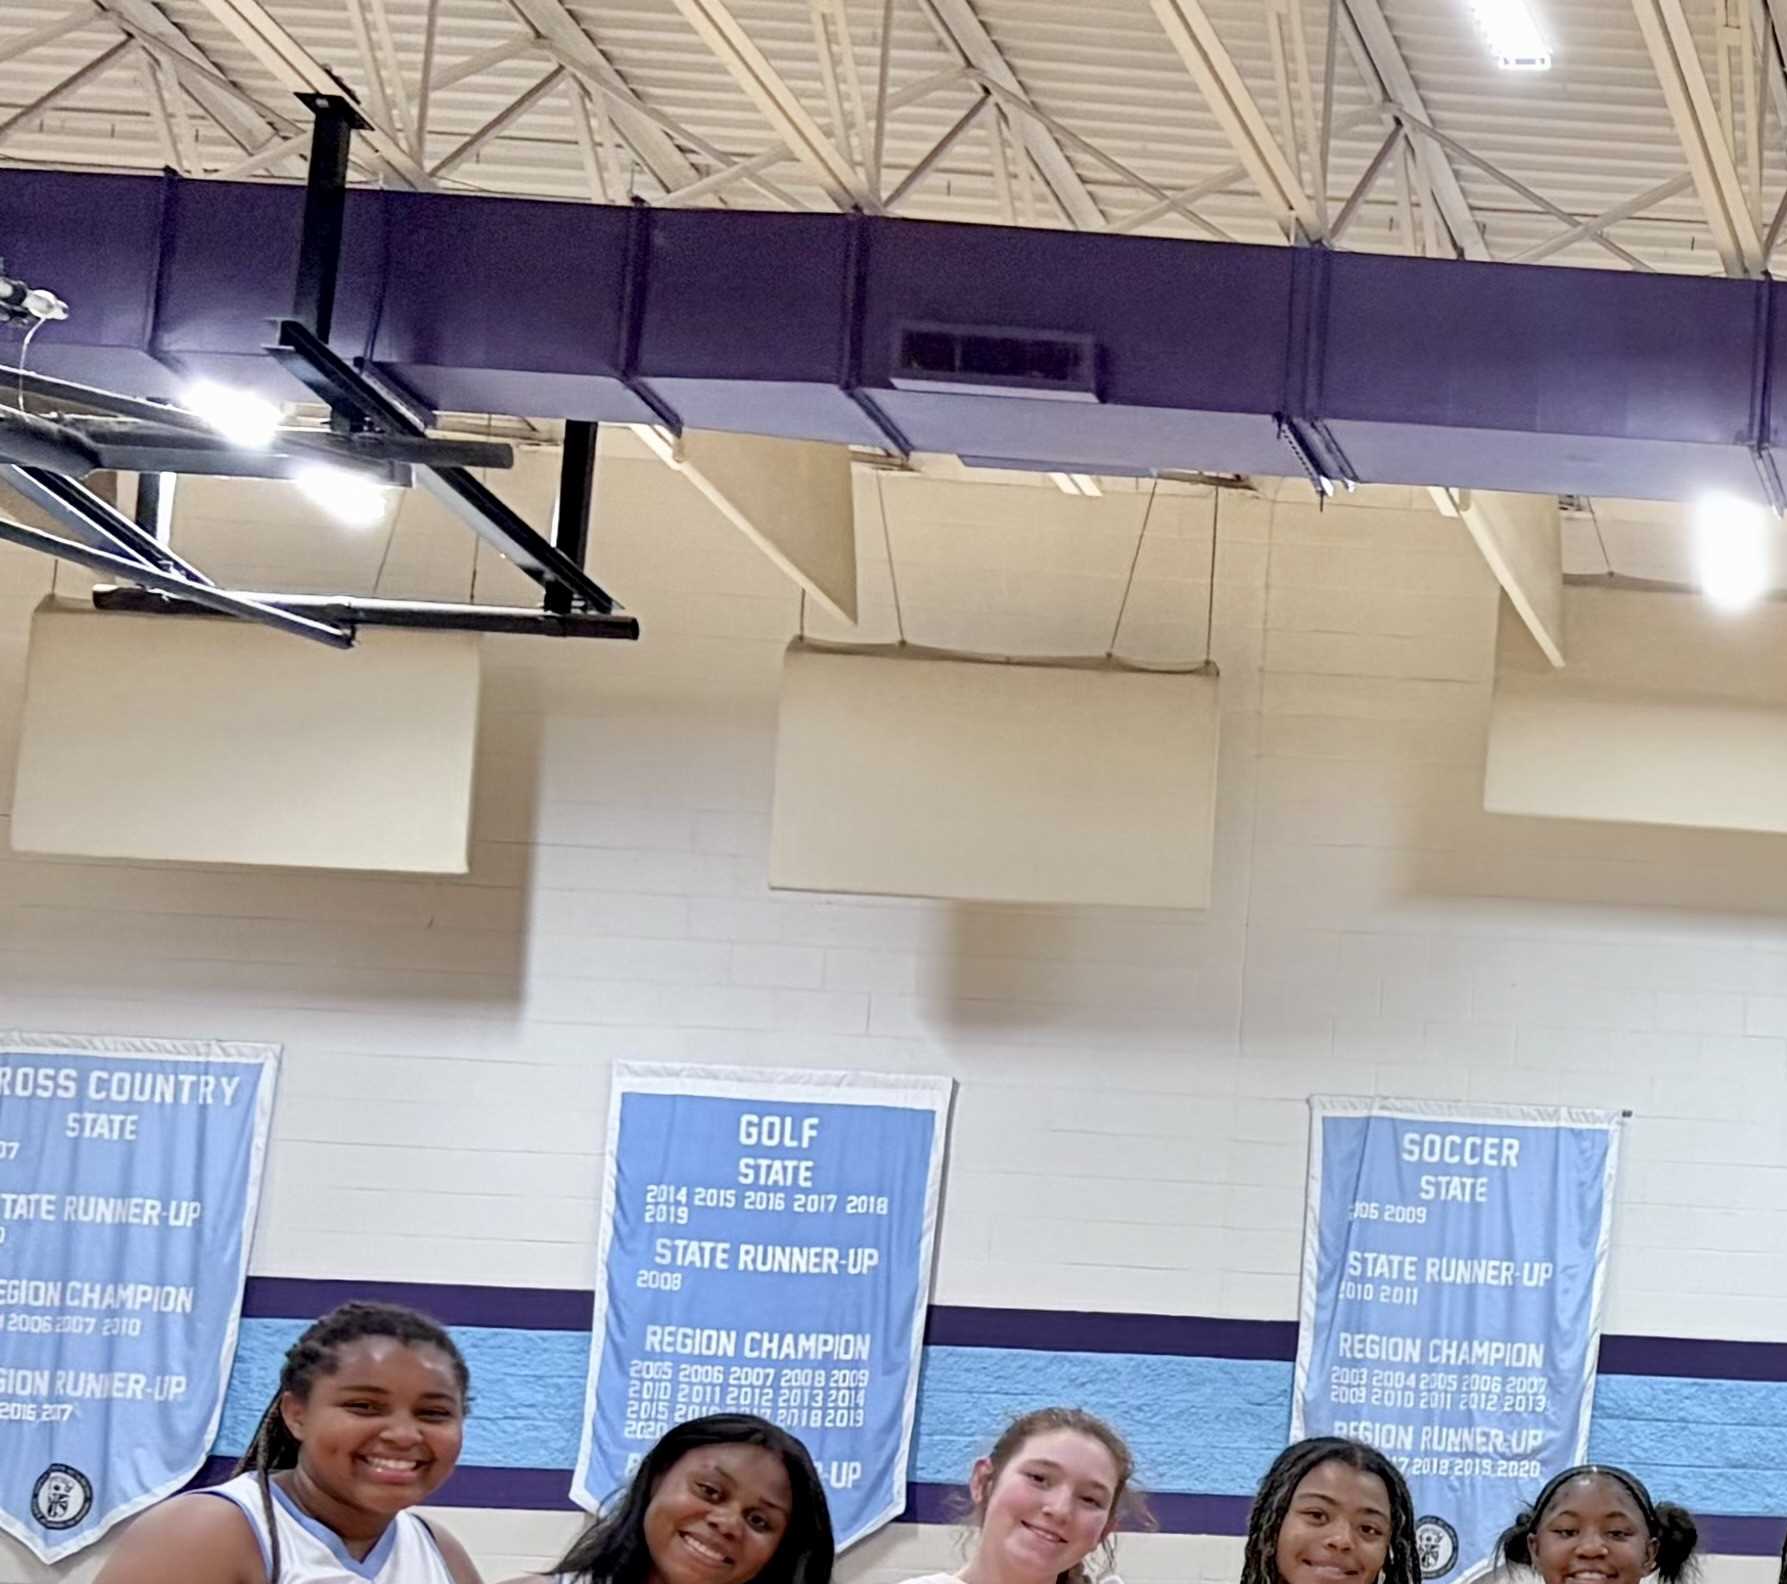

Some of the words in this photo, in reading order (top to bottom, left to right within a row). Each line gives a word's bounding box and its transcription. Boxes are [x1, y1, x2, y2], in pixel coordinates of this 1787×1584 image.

[0, 1066, 78, 1099] ROSS
[88, 1070, 240, 1106] COUNTRY
[65, 1111, 139, 1140] STATE
[738, 1113, 820, 1149] GOLF
[1401, 1133, 1520, 1167] SOCCER
[737, 1157, 815, 1188] STATE
[645, 1184, 688, 1205] 2014
[693, 1187, 736, 1209] 2015
[743, 1190, 786, 1211] 2016
[792, 1193, 838, 1214] 2017
[846, 1195, 889, 1216] 2018
[1419, 1174, 1488, 1203] STATE
[0, 1193, 56, 1221] TATE
[64, 1195, 201, 1227] RUNNER-UP
[644, 1204, 688, 1225] 2019
[1384, 1203, 1427, 1223] 2009
[654, 1238, 730, 1270] STATE
[738, 1243, 879, 1275] RUNNER-UP
[1348, 1251, 1418, 1281] STATE
[1425, 1256, 1553, 1287] RUNNER-UP
[636, 1269, 683, 1291] 2008
[1380, 1284, 1418, 1305] 2011
[0, 1279, 65, 1308] EGION
[66, 1281, 194, 1313] CHAMPION
[645, 1325, 736, 1358] REGION
[743, 1330, 871, 1361] CHAMPION
[1338, 1332, 1421, 1364] REGION
[1428, 1338, 1545, 1368] CHAMPION
[629, 1360, 672, 1379] 2005
[678, 1364, 724, 1384] 2006
[728, 1367, 775, 1387] 2007
[780, 1368, 826, 1388] 2008
[1372, 1369, 1416, 1389] 2004
[628, 1380, 671, 1400] 2010
[677, 1383, 721, 1404] 2011
[726, 1387, 773, 1406] 2012
[778, 1388, 824, 1408] 2013
[827, 1389, 866, 1408] 2014
[1371, 1388, 1415, 1408] 2010
[1419, 1391, 1451, 1409] 2011
[1459, 1393, 1499, 1411] 2012
[1503, 1394, 1547, 1412] 2013
[626, 1400, 669, 1421] 2015
[777, 1407, 822, 1427] 2018
[1421, 1425, 1544, 1454] RUNNER-UP
[1412, 1457, 1449, 1475] 2018
[1497, 1459, 1540, 1476] 2020
